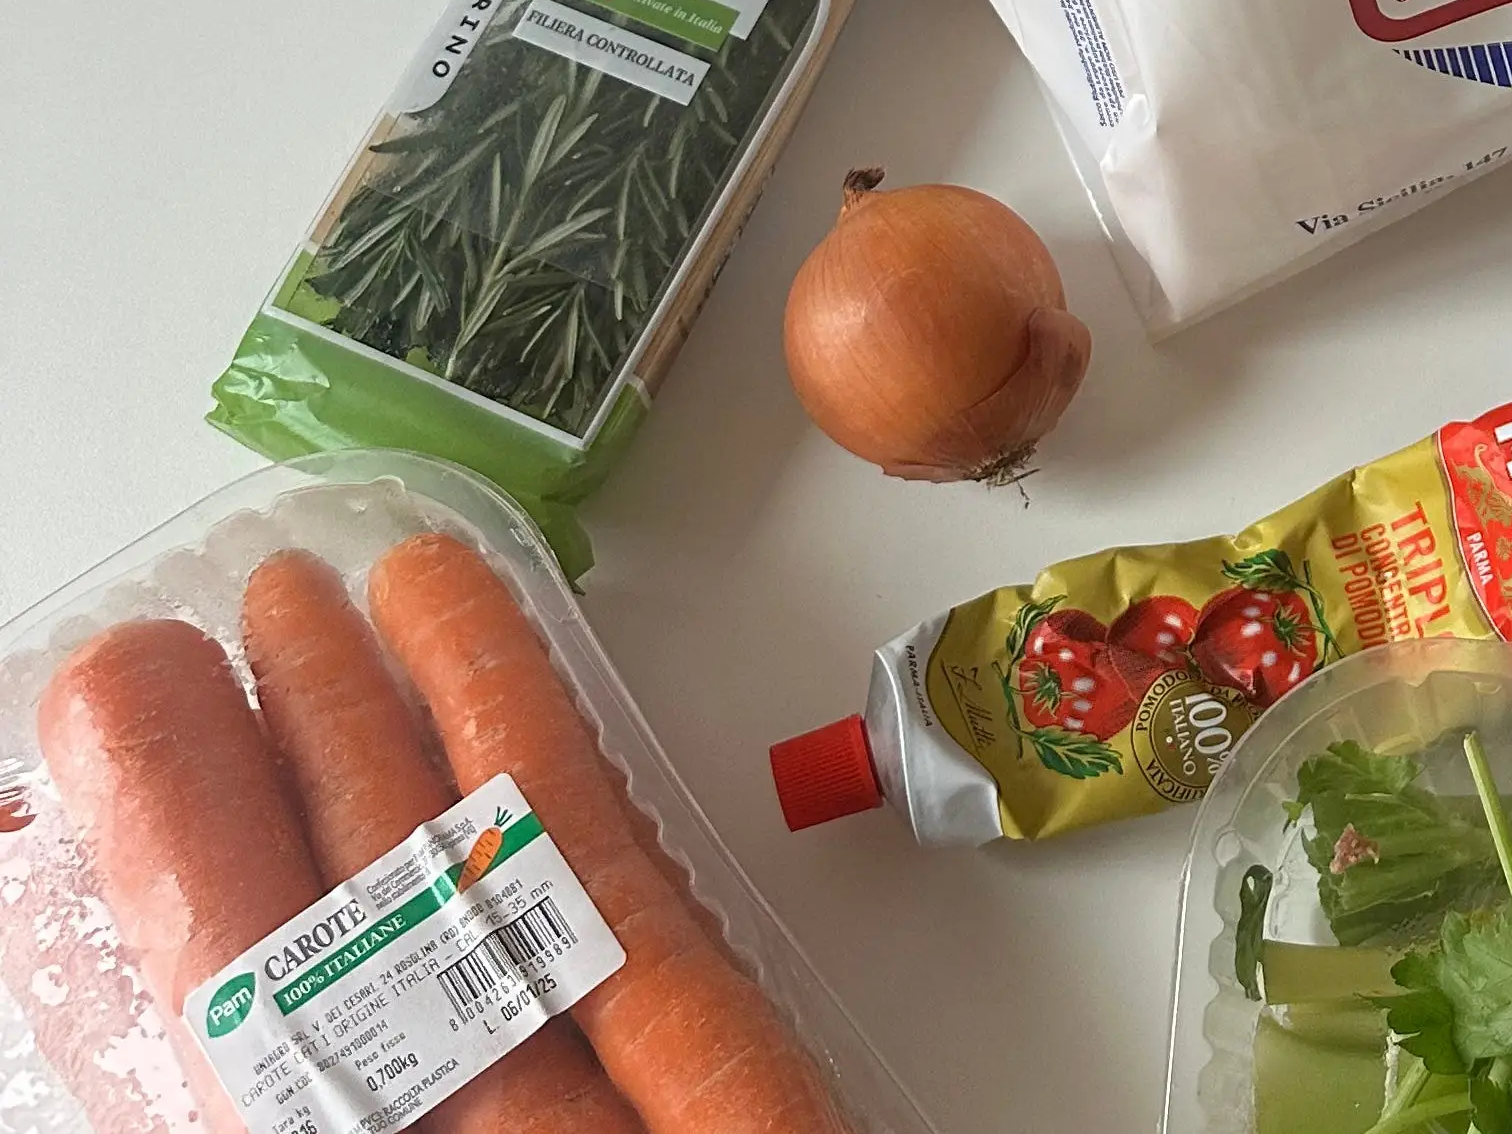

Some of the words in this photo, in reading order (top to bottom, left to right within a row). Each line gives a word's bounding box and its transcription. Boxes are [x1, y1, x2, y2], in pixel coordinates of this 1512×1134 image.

[673, 2, 688, 20] in
[686, 3, 724, 35] Italia
[526, 9, 585, 43] FILIERA
[585, 33, 696, 88] CONTROLLATA
[1296, 213, 1349, 235] Via
[1331, 532, 1362, 560] DI
[1390, 501, 1452, 639] TRIPL
[1467, 531, 1494, 586] PARMA
[1339, 561, 1389, 650] POMODO
[1360, 523, 1411, 641] CONCENTR
[1136, 670, 1200, 733] POMODO
[1169, 699, 1196, 775] ITALIANO
[264, 898, 367, 981] CAROTE
[283, 972, 325, 1005] 100%
[325, 914, 407, 976] ITALIANE
[241, 1063, 292, 1107] CAROTE
[334, 996, 389, 1038] ORIGINE
[391, 957, 440, 997] ITALIA
[485, 899, 527, 926] 15-35
[530, 879, 554, 901] mm
[380, 970, 394, 985] 24
[501, 973, 558, 1022] 06/01/25
[209, 987, 252, 1027] Pam
[355, 1050, 379, 1070] Peso
[382, 1032, 407, 1053] fisso
[367, 1053, 419, 1092] 0,700kg
[297, 1105, 312, 1120] kg
[382, 1087, 425, 1116] RACCOLTA
[422, 1058, 461, 1089] PLASTICA
[388, 1098, 424, 1125] COMUNE
